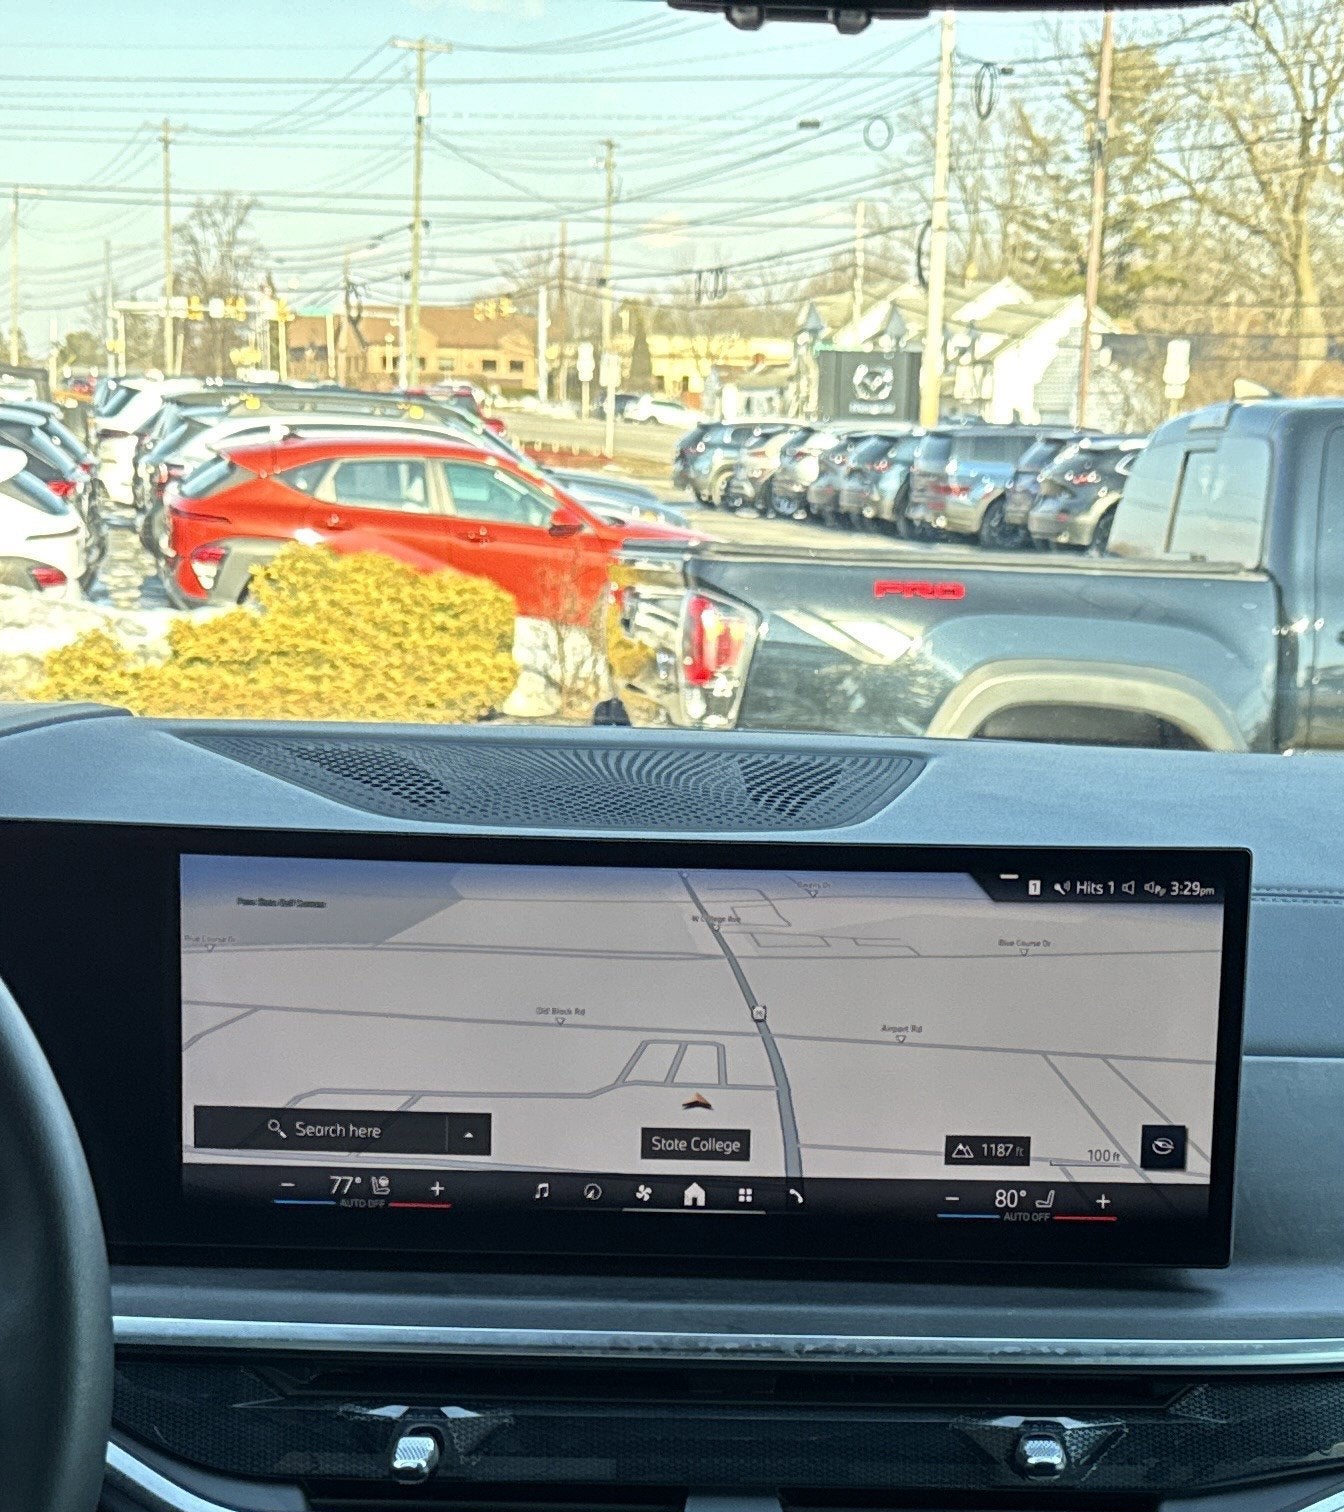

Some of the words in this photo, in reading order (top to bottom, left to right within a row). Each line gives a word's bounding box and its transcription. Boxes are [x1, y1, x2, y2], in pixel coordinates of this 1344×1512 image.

[873, 580, 966, 600] PRO
[1076, 881, 1104, 896] Hits
[1170, 881, 1215, 897] 3:29pm
[295, 1122, 346, 1138] Search
[349, 1123, 382, 1139] here
[652, 1136, 687, 1151] State
[691, 1137, 741, 1155] College
[982, 1144, 1013, 1157] 1187
[1088, 1150, 1110, 1162] 100
[1113, 1153, 1121, 1161] ft
[330, 1175, 361, 1195] 77°
[339, 1199, 366, 1208] AUTO
[994, 1189, 1027, 1208] 80°
[1003, 1211, 1029, 1222] AUTO
[1032, 1212, 1050, 1222] OFF
